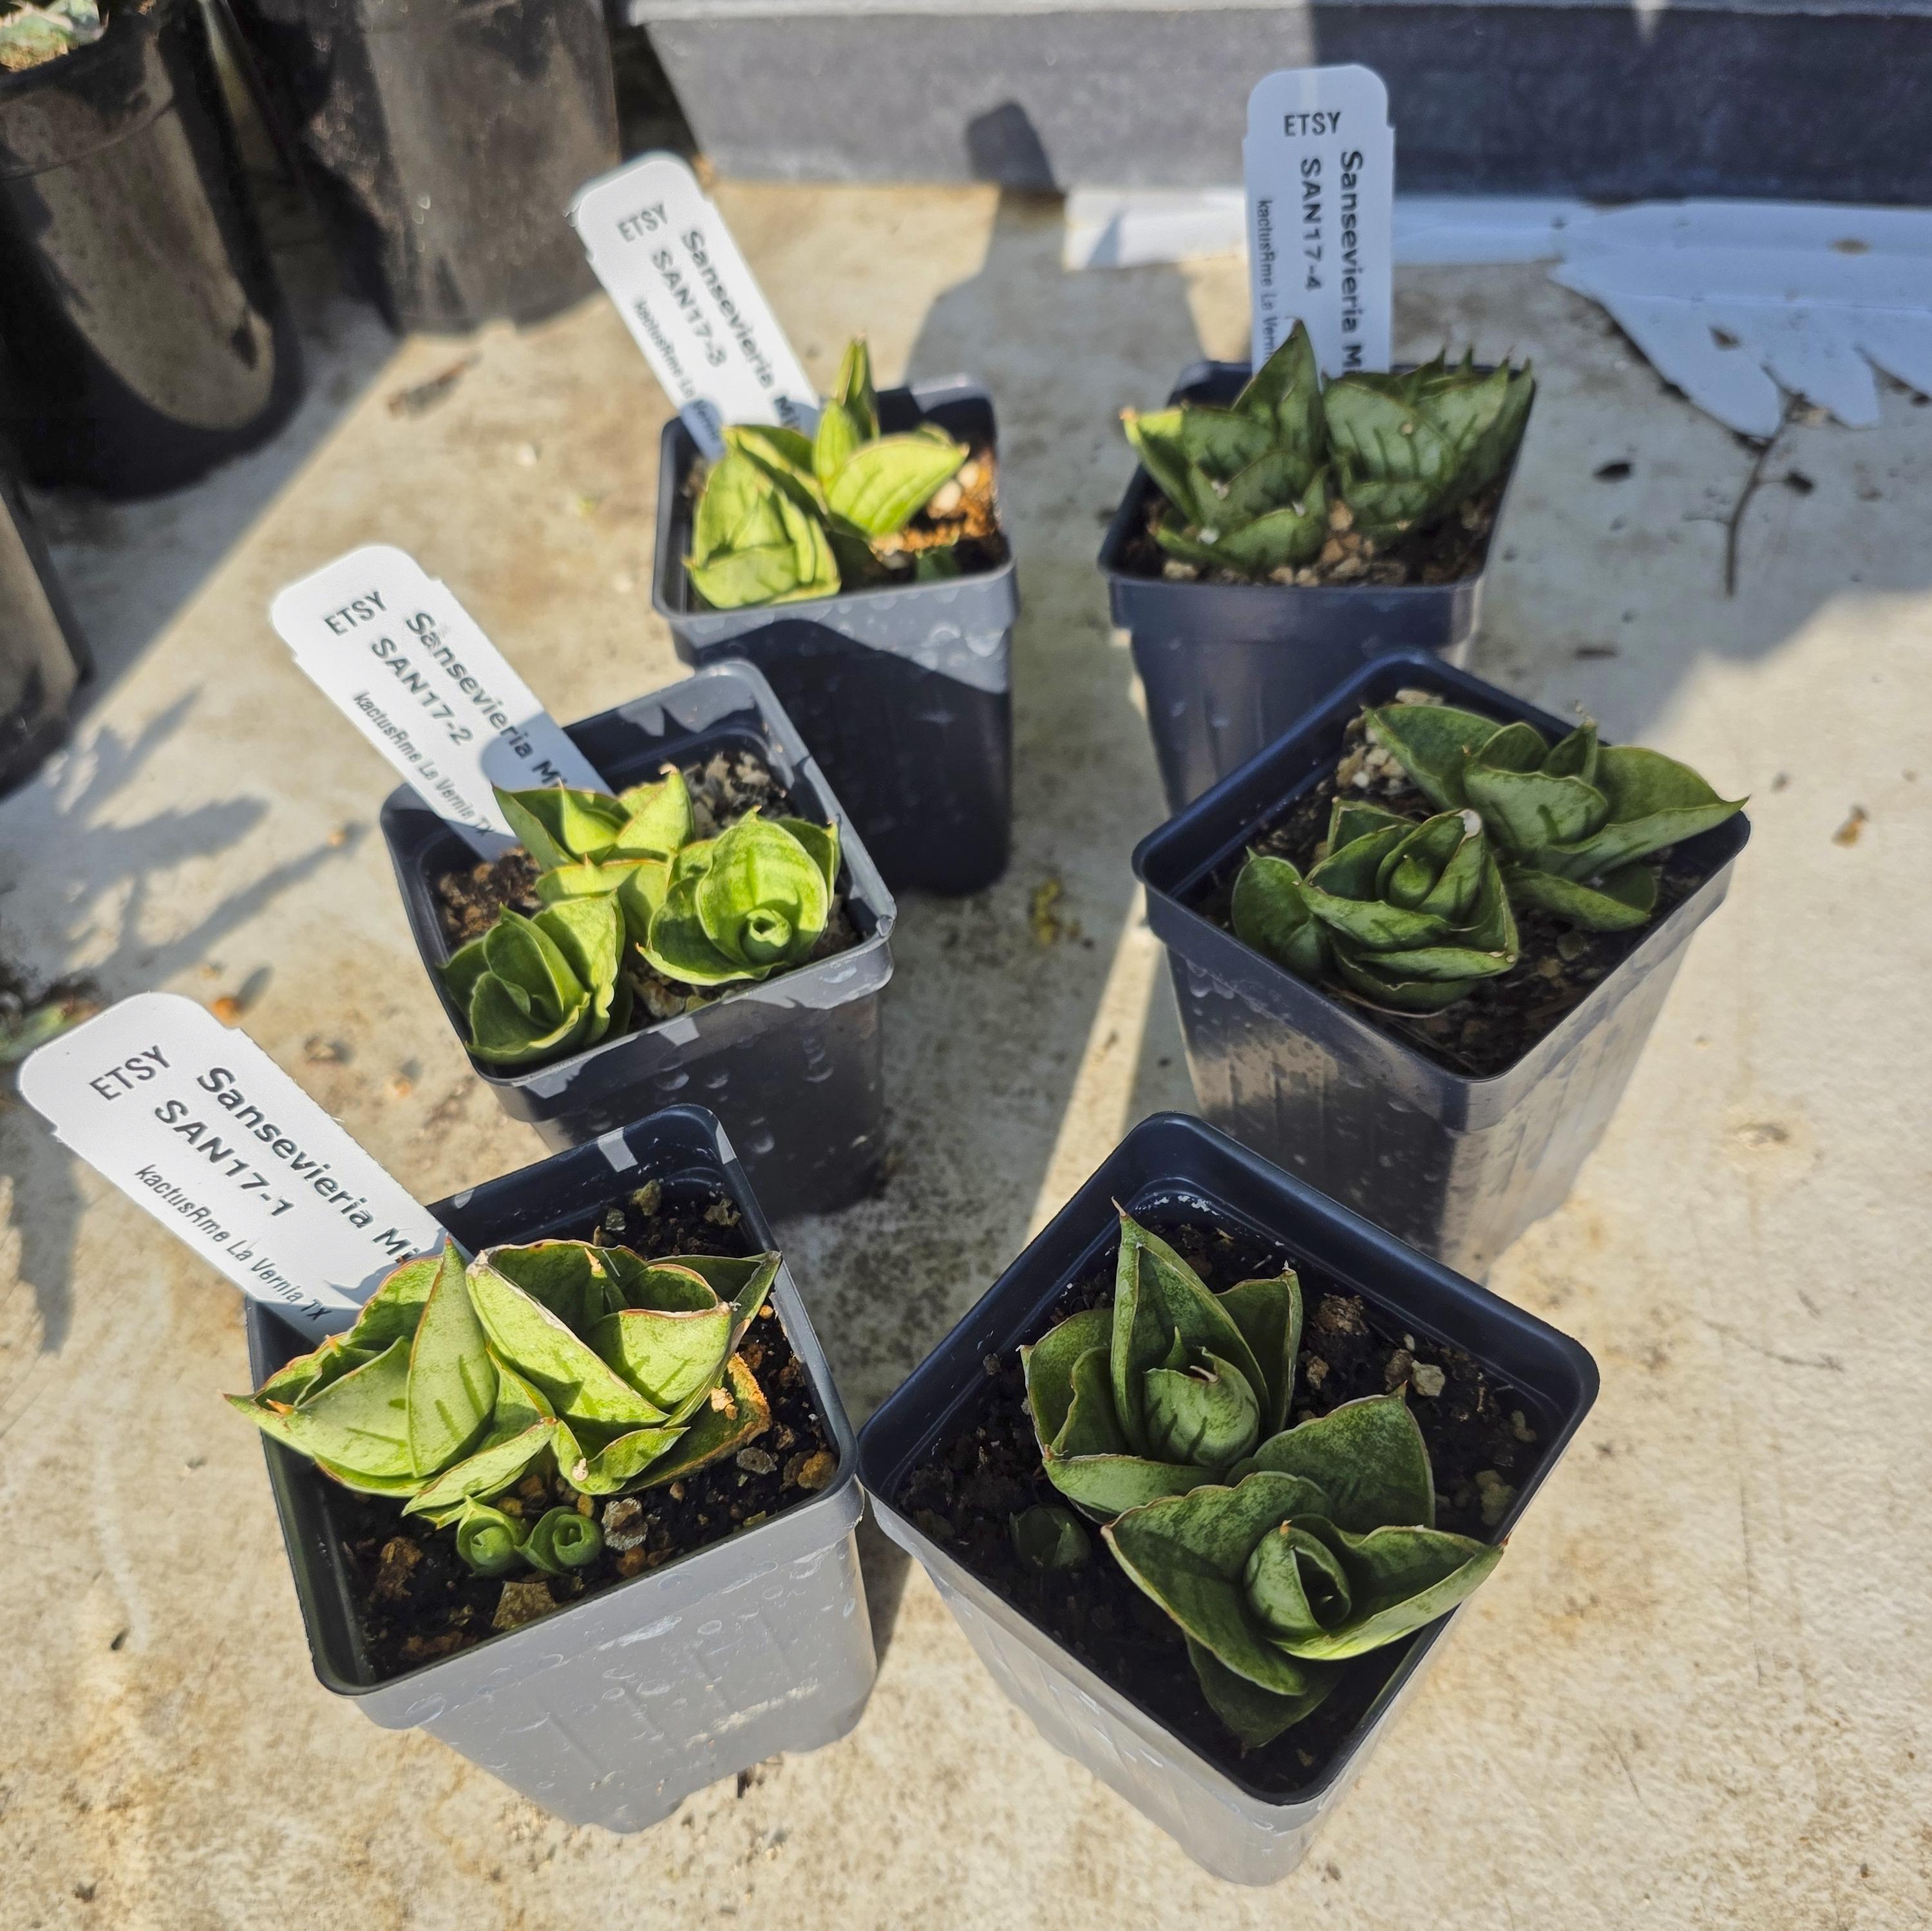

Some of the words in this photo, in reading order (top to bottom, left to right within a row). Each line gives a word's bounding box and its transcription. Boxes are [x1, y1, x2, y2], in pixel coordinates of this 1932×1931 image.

[1283, 111, 1341, 137] ETSY
[615, 203, 668, 243] ETSY
[1301, 157, 1322, 293] SAN17-4
[1341, 151, 1363, 334] Sansevieria
[652, 250, 727, 367] SAN17-3
[681, 230, 774, 388] Sansevieria
[1343, 344, 1363, 371] M
[323, 590, 388, 636] ETSY
[372, 637, 474, 746] SAN17-2
[406, 612, 534, 760] Sansevieria
[417, 760, 439, 781] La
[435, 778, 476, 820] Vernia
[475, 815, 496, 836] TX
[89, 1045, 171, 1100] ETSY
[155, 1099, 295, 1217] SAN17-1
[196, 1067, 375, 1229] Sansevieria
[226, 1238, 252, 1261] La
[251, 1258, 304, 1305] Vernia
[301, 1299, 332, 1321] TX
